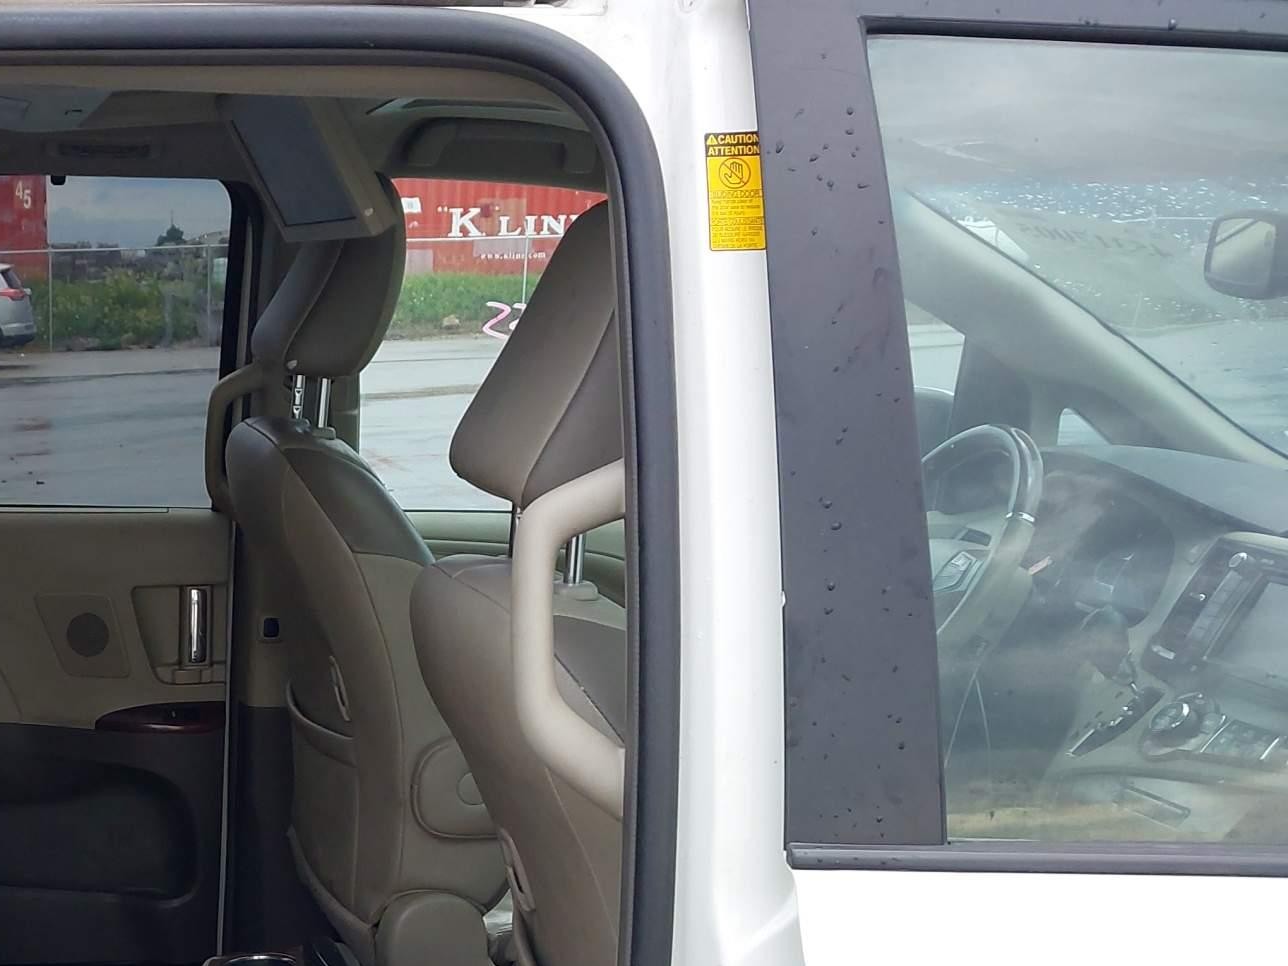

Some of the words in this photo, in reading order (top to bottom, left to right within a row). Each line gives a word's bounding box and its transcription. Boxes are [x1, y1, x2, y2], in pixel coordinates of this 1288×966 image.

[717, 134, 760, 145] CAUTION
[707, 145, 761, 156] ATTENTION
[15, 180, 32, 209] 45
[480, 250, 546, 260] www.klinecom
